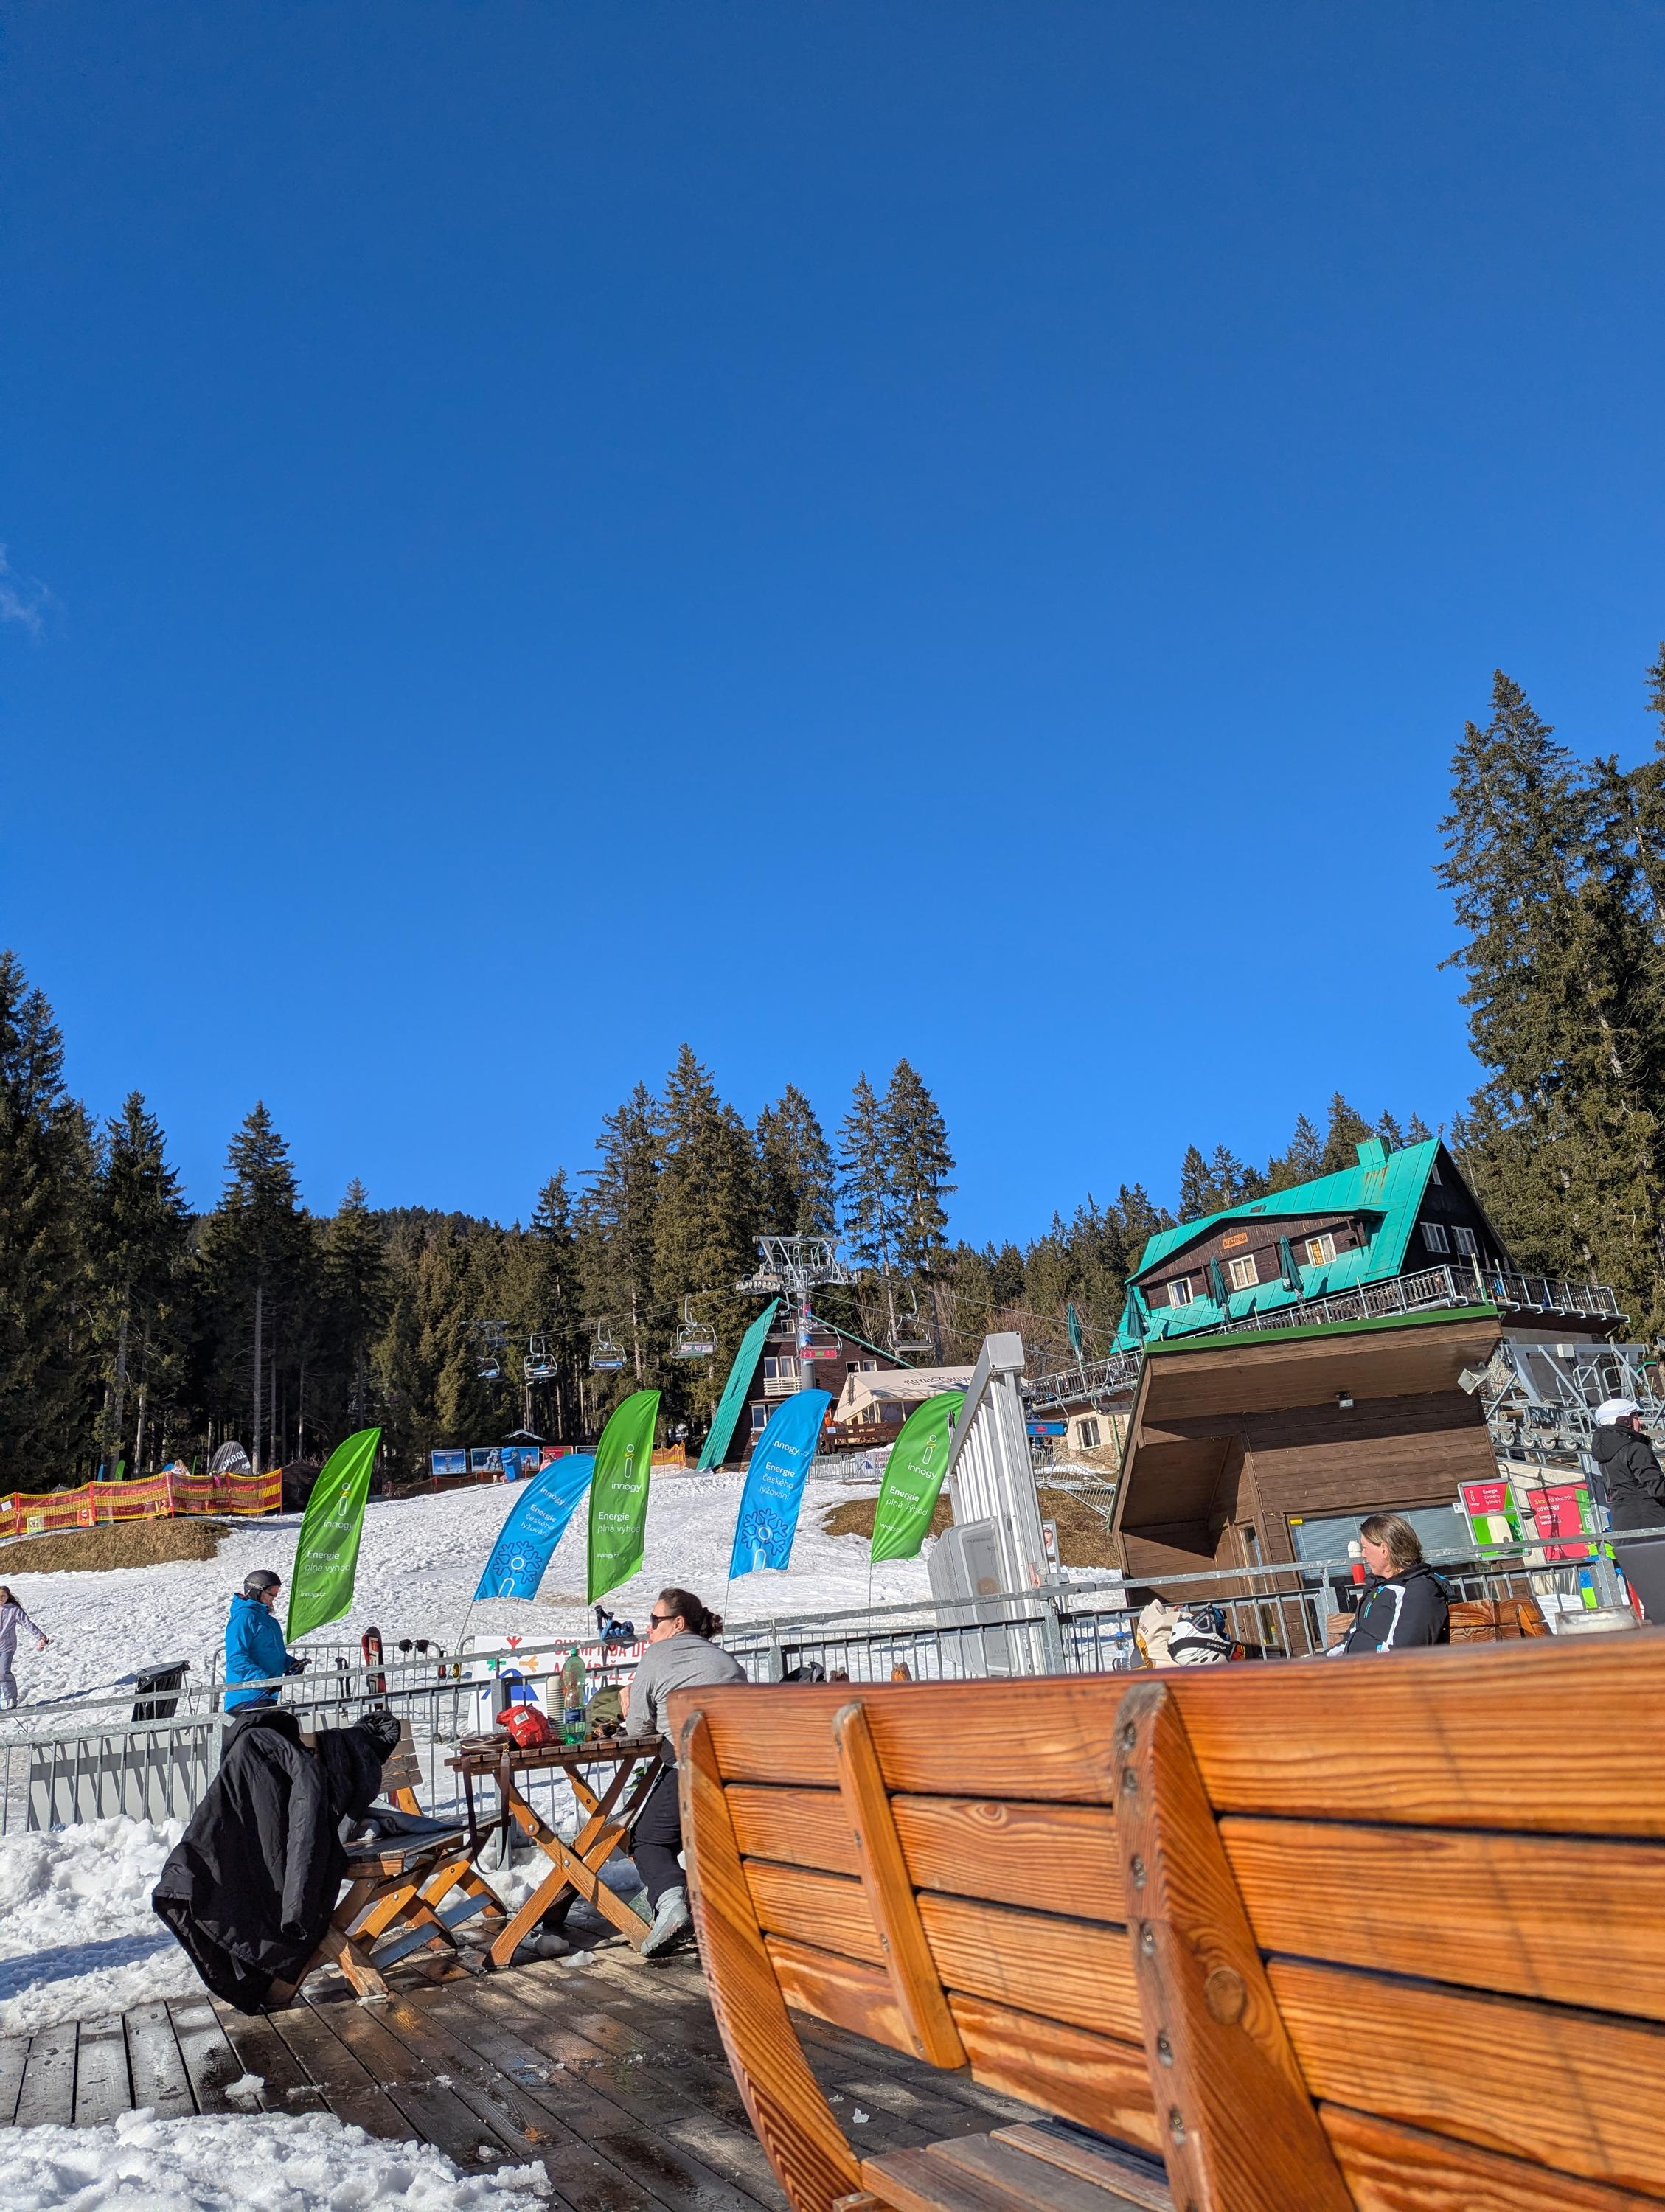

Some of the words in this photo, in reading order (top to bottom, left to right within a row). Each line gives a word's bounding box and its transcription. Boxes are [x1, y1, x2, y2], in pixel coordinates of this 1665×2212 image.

[765, 1461, 796, 1478] Energie
[908, 1462, 937, 1480] innogy
[611, 1481, 642, 1492] innogy
[762, 1473, 794, 1489] českého
[889, 1486, 920, 1503] Energie
[530, 1504, 557, 1523] Energie
[885, 1498, 903, 1509] plná
[905, 1503, 928, 1517] výhod
[525, 1512, 555, 1531] českého
[599, 1511, 630, 1522] Energie
[323, 1520, 354, 1531] innogy
[597, 1524, 615, 1534] plná
[616, 1524, 641, 1534] výhod
[307, 1550, 340, 1561] Energie
[305, 1563, 323, 1575] plná
[324, 1562, 351, 1573] výhod
